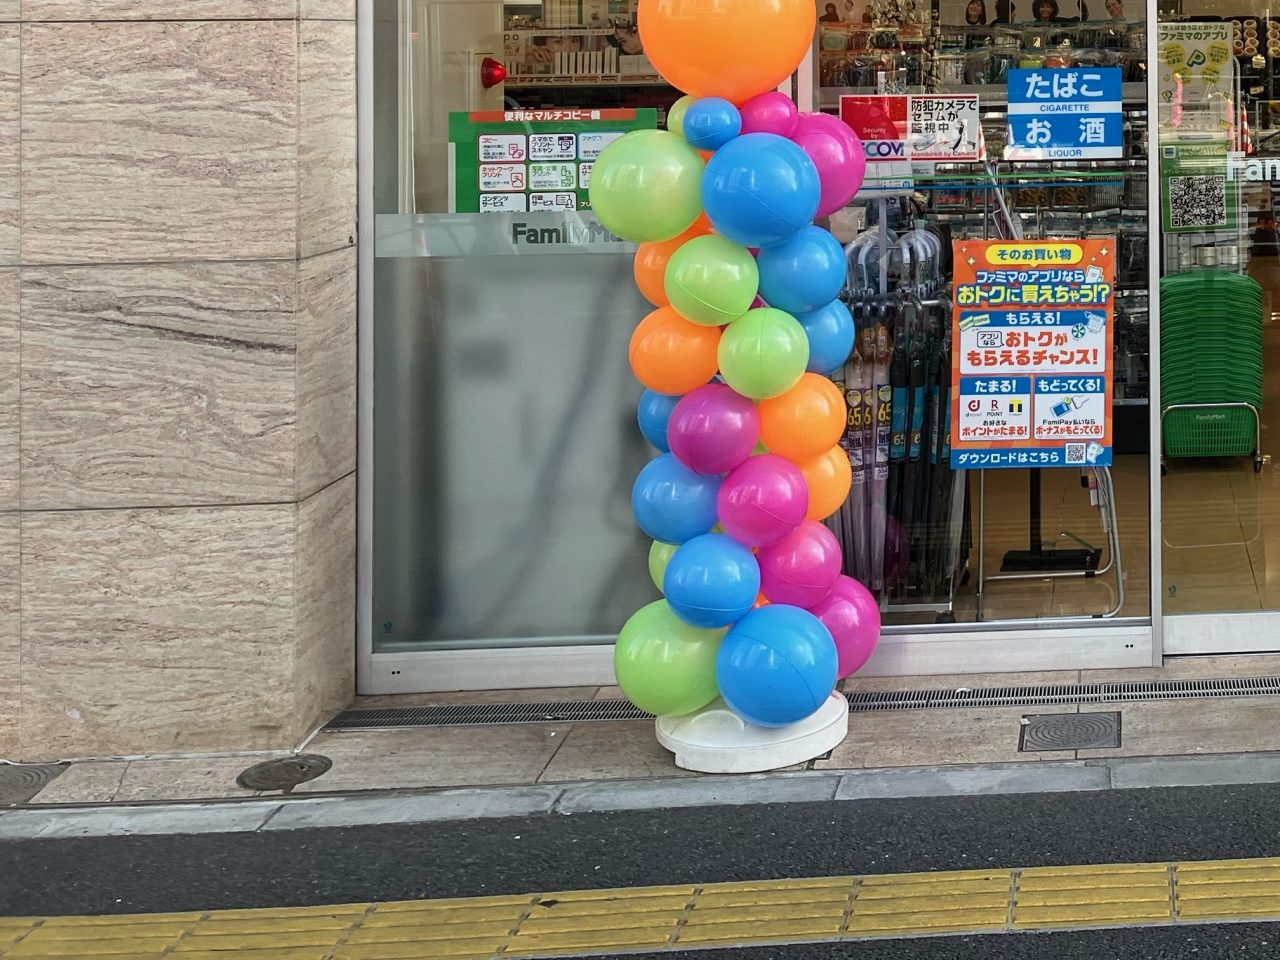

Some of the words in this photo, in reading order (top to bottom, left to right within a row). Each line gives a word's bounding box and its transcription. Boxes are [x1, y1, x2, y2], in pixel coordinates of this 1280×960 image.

[1161, 31, 1228, 40] ファミマのアプリ
[1025, 74, 1104, 97] たばこ
[911, 100, 977, 111] 防犯カメラで
[1039, 103, 1090, 112] CIGARETTE
[504, 110, 600, 121] 便利なマルチコピー機
[911, 111, 958, 121] セコムが
[911, 123, 949, 133] 監視中
[861, 141, 904, 157] COM
[1048, 148, 1082, 158] LIQUOR
[997, 248, 1072, 260] そのお買い物
[976, 270, 1085, 284] ファミマのアプリなら
[958, 284, 1110, 304] おトクに買えちゃう!?
[1006, 312, 1060, 325] もらえる!
[1006, 331, 1068, 347] おトクが
[967, 348, 1098, 366] もらえるチャンス!
[975, 379, 1016, 393] たまる!
[1038, 379, 1100, 392] もどってくる!
[962, 426, 1027, 437] ポイントがたまる!
[1036, 425, 1102, 436] ボーナスがもどってくる!
[958, 452, 1059, 464] ダウンロードはこちら
